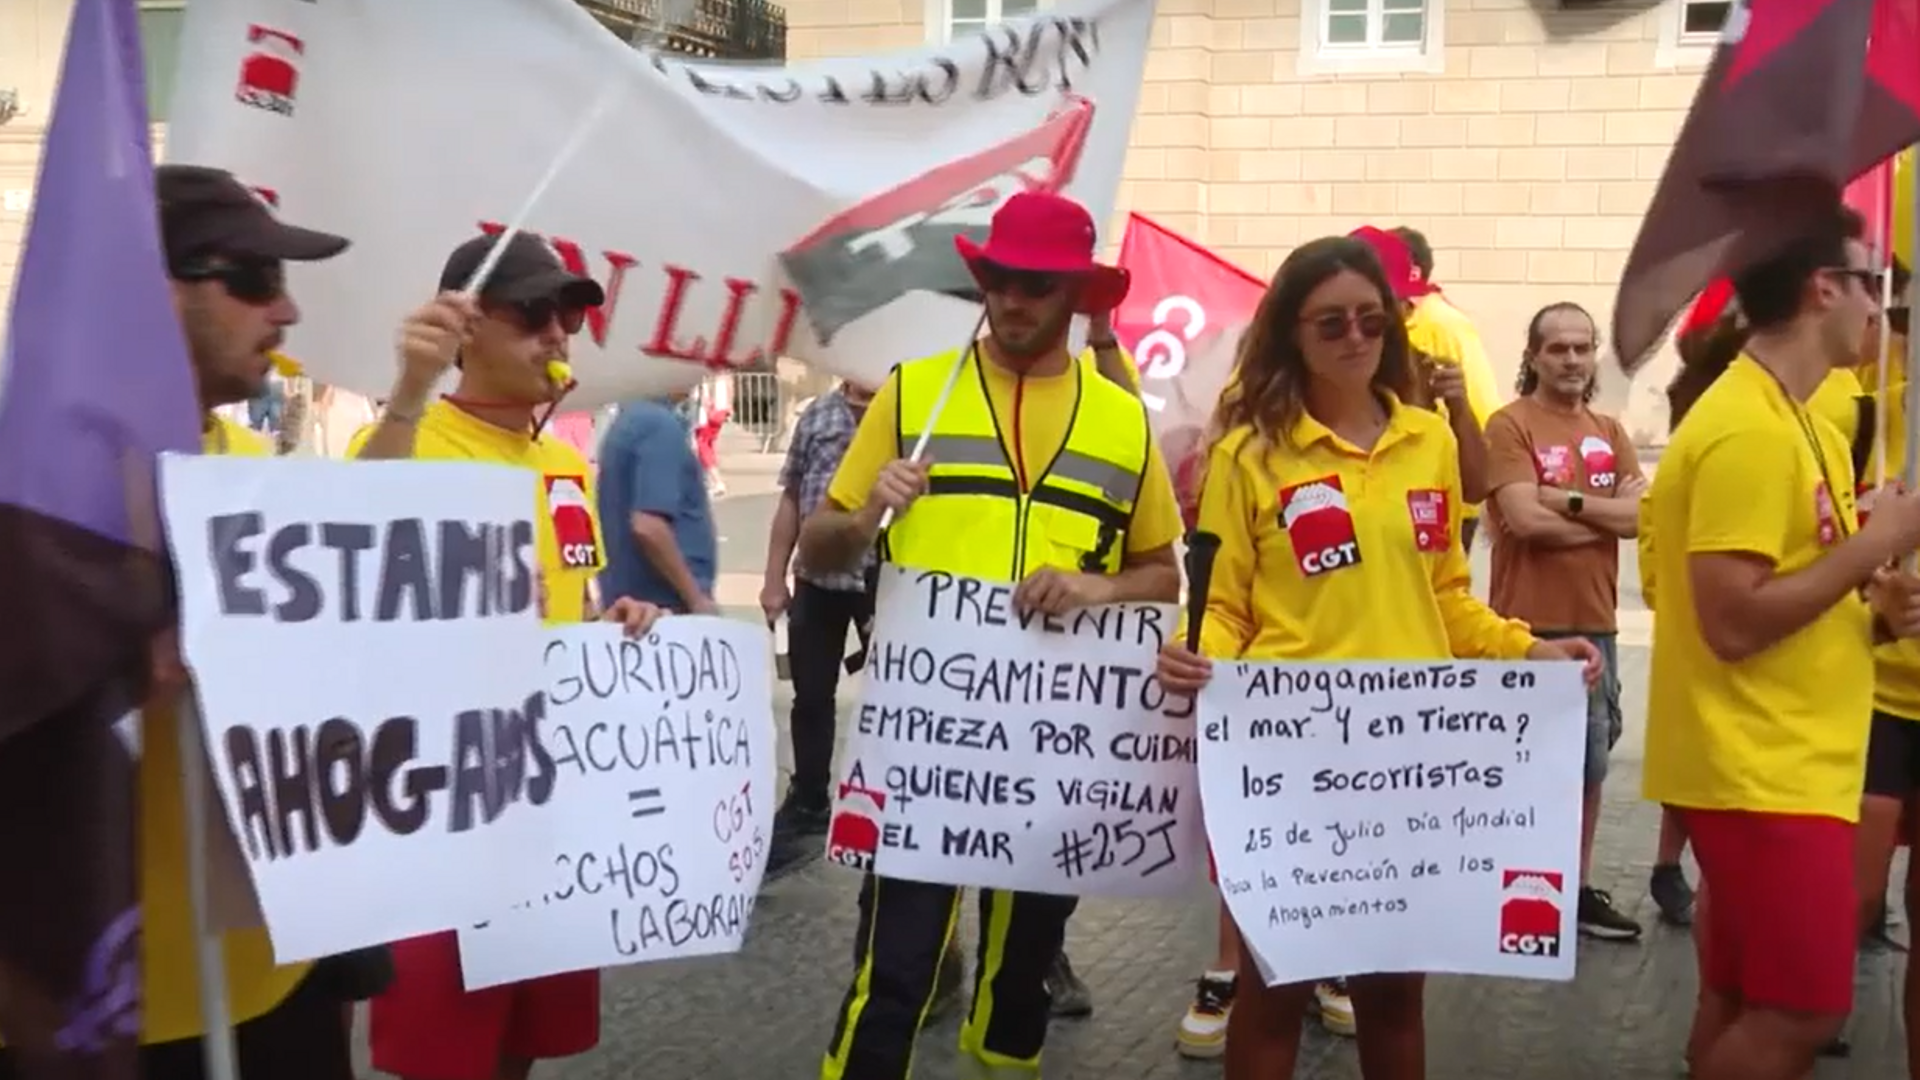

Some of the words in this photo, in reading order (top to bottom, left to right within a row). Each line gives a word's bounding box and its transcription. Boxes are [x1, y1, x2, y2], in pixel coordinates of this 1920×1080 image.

[562, 543, 595, 565] CGT
[1302, 541, 1356, 573] CGT
[1501, 669, 1536, 689] en
[1204, 714, 1229, 742] el
[1368, 714, 1405, 738] en
[847, 759, 866, 790] A
[1242, 765, 1284, 799] los
[713, 779, 753, 844] CGT
[881, 822, 920, 850] EL
[1052, 818, 1178, 879] #25J
[1285, 820, 1313, 846] de
[1325, 819, 1385, 858] Julio
[830, 845, 873, 871] CGT
[1410, 858, 1442, 879] de
[1459, 854, 1495, 873] los
[1502, 933, 1557, 956] CGT
